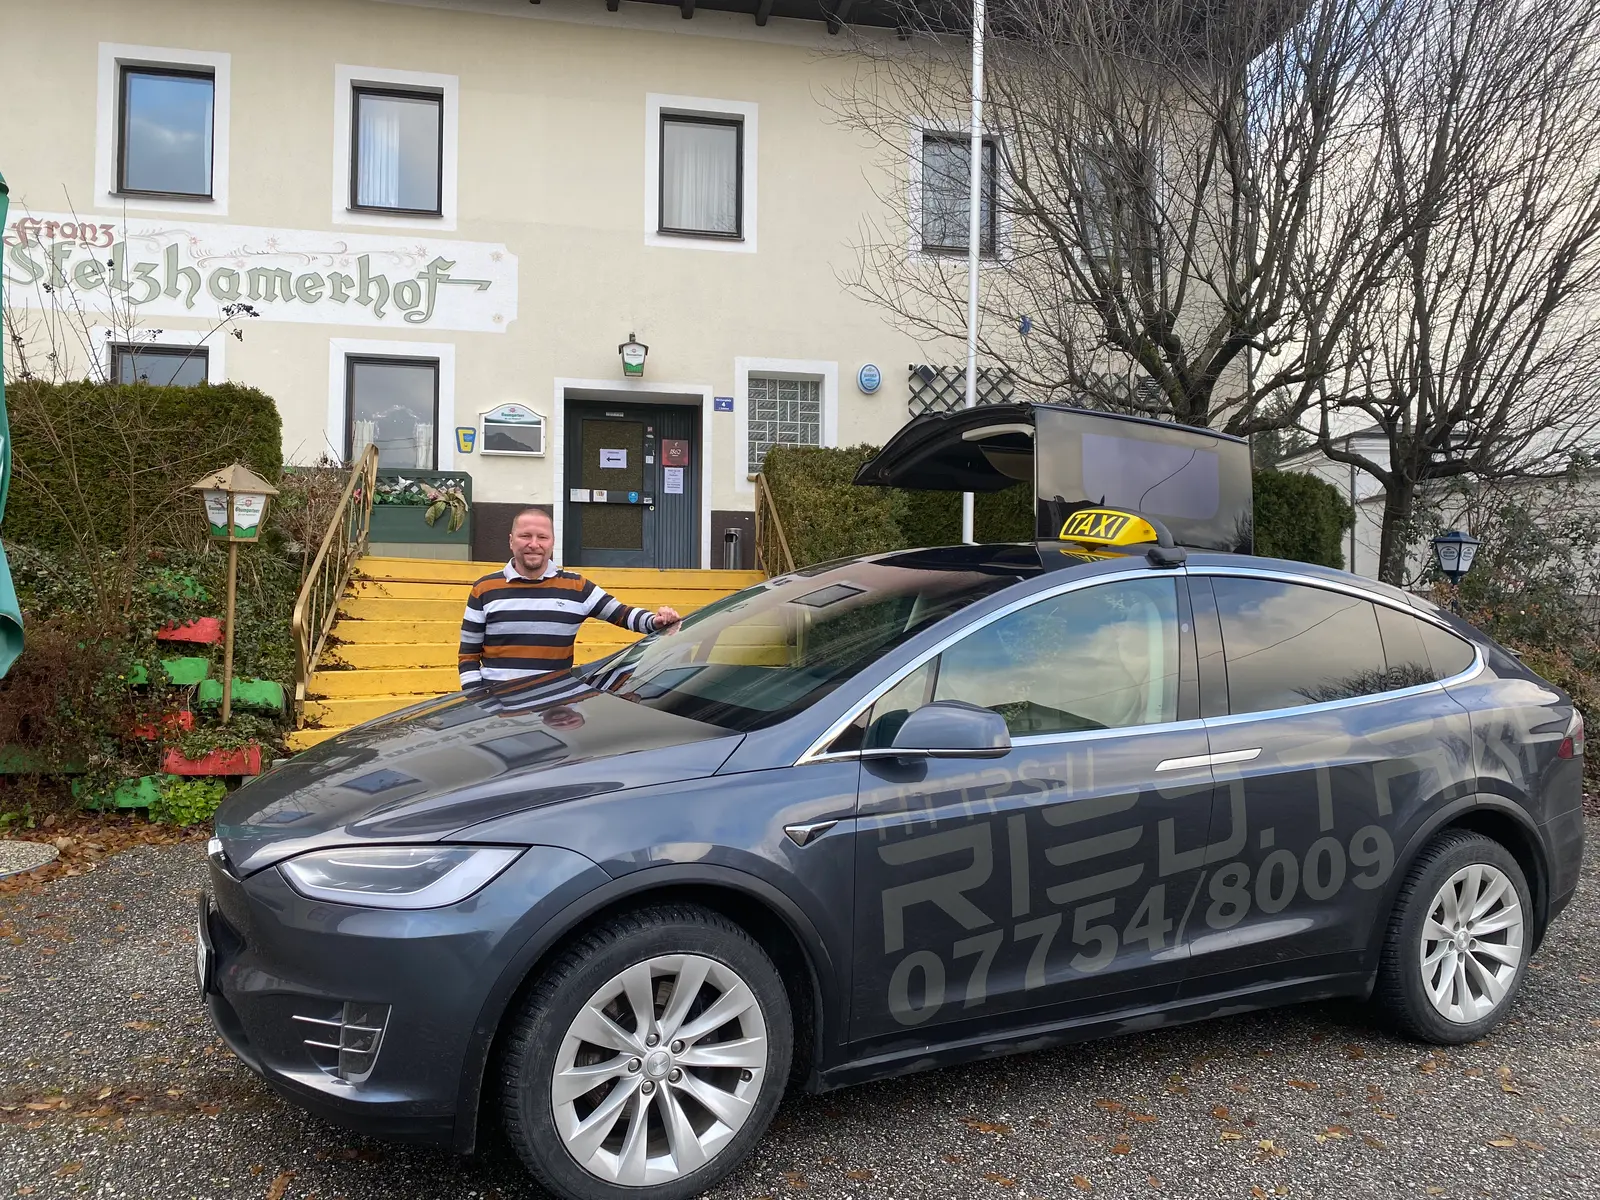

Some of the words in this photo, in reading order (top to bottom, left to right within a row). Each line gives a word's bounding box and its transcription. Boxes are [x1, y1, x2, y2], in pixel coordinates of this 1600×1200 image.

[3, 217, 116, 250] Franz
[2, 240, 492, 324] Stelzhamerhof
[1067, 513, 1124, 538] TAXI
[887, 824, 1396, 1027] 07754/8009
